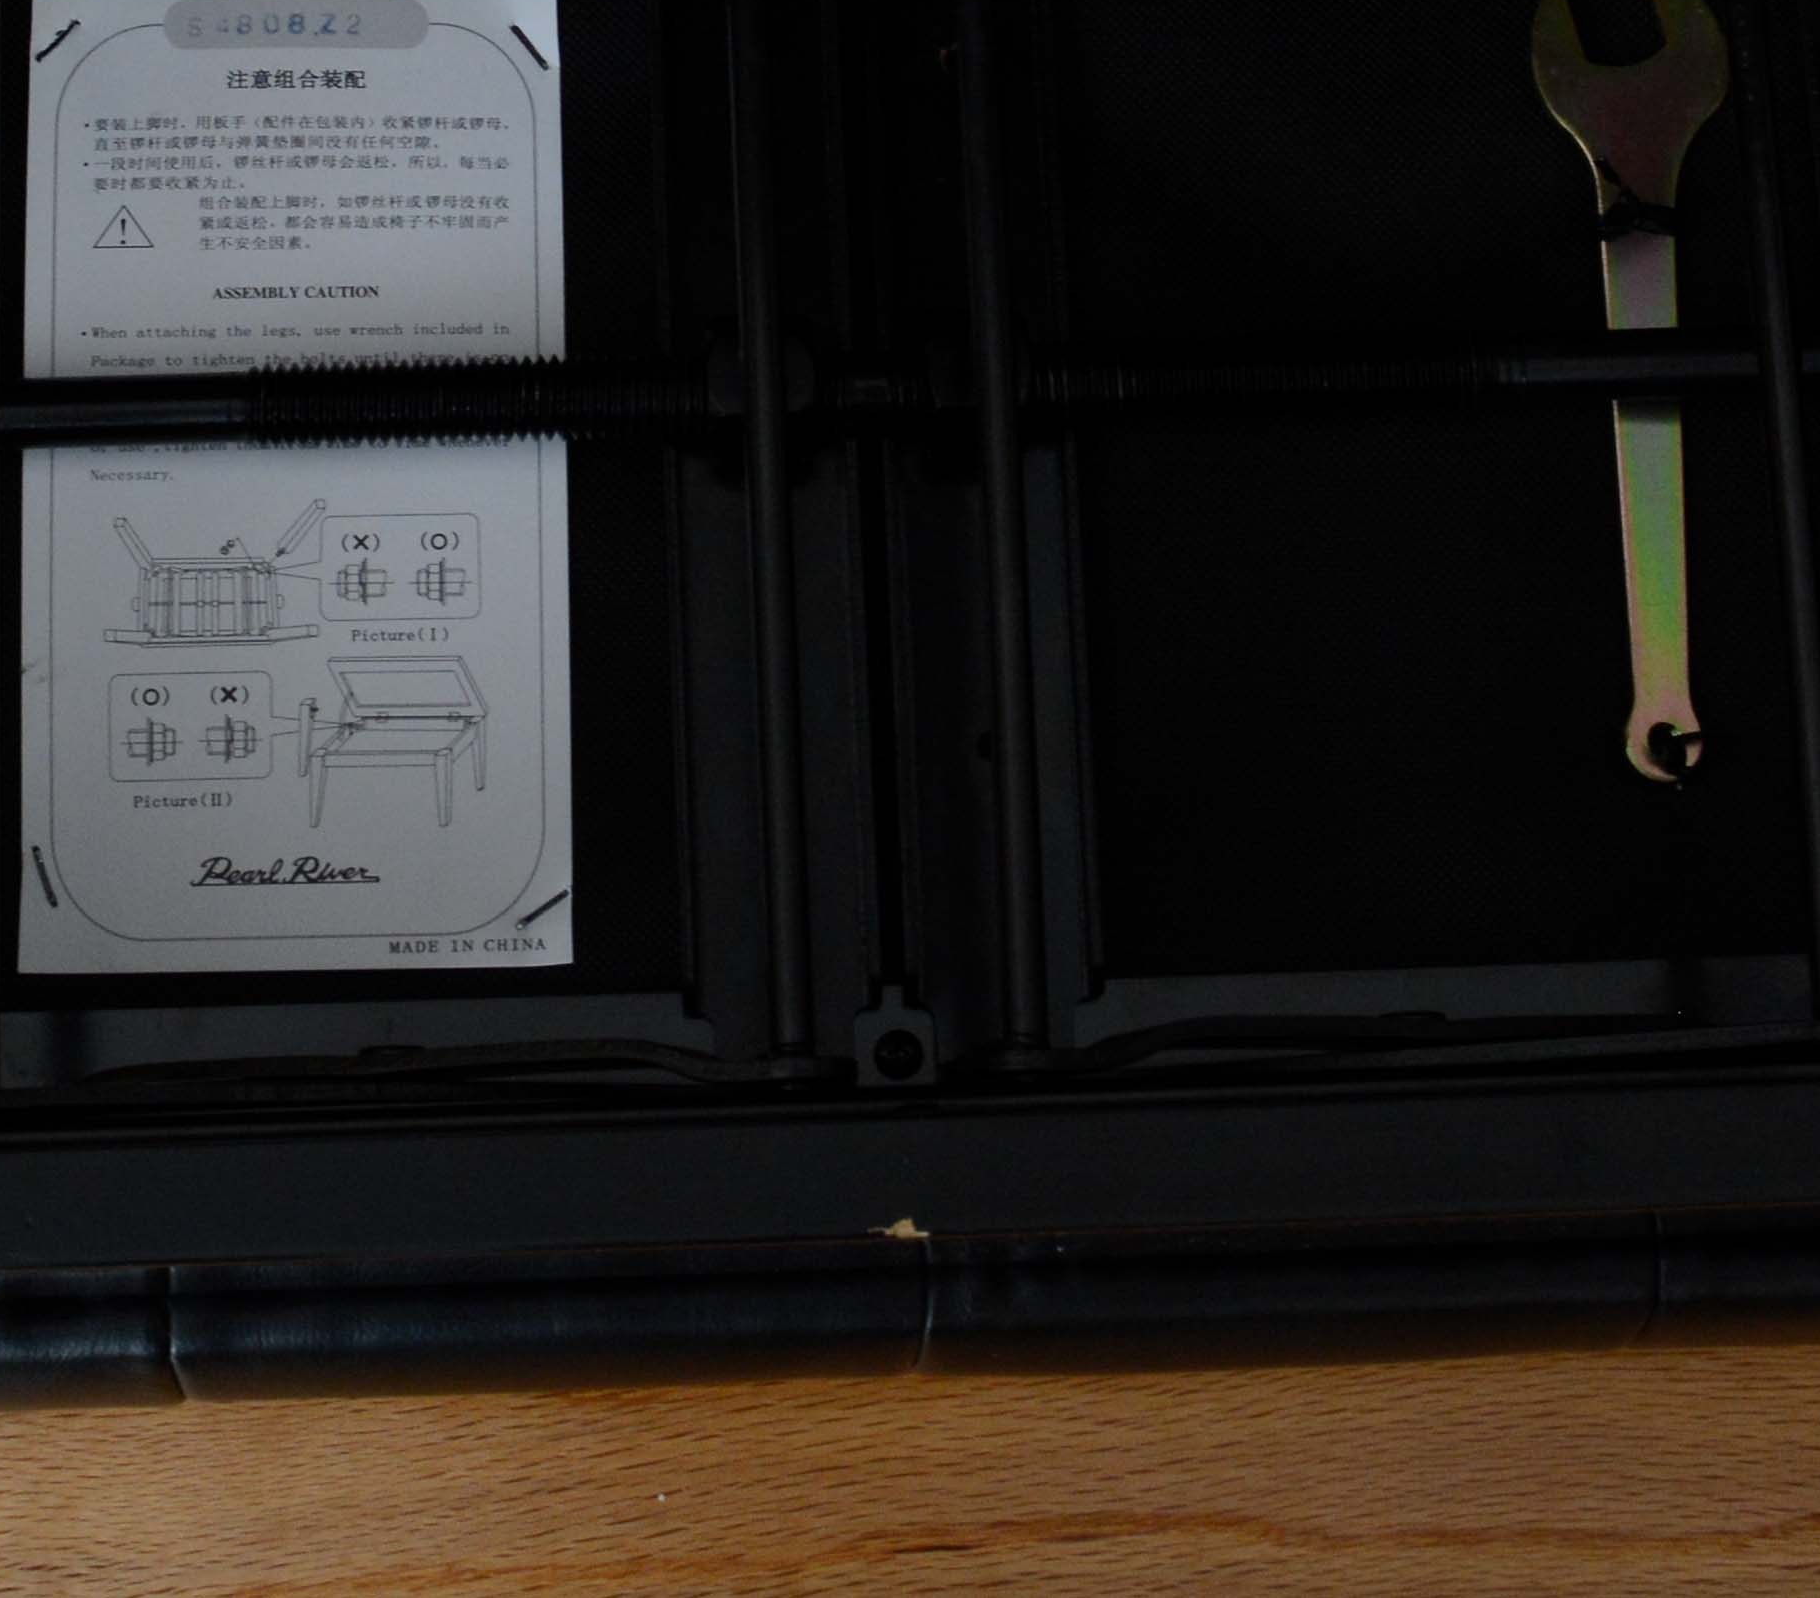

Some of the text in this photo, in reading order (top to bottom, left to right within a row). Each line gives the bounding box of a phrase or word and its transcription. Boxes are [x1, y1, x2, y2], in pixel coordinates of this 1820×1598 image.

[227, 69, 367, 89] 注意组合装配
[213, 286, 379, 299] ASSEMBLY CAUTION
[91, 327, 127, 338] When
[136, 325, 217, 339] attaching
[226, 325, 252, 337] the
[314, 327, 341, 336] use
[349, 323, 403, 336] wrench
[413, 322, 483, 335] included
[493, 323, 509, 335] in
[91, 355, 155, 367] Package
[165, 356, 183, 366] to
[192, 354, 255, 366] tighten
[90, 469, 173, 482] Necessary.
[190, 856, 381, 887] Pearl River
[389, 938, 546, 954] MADE IN CHINA
